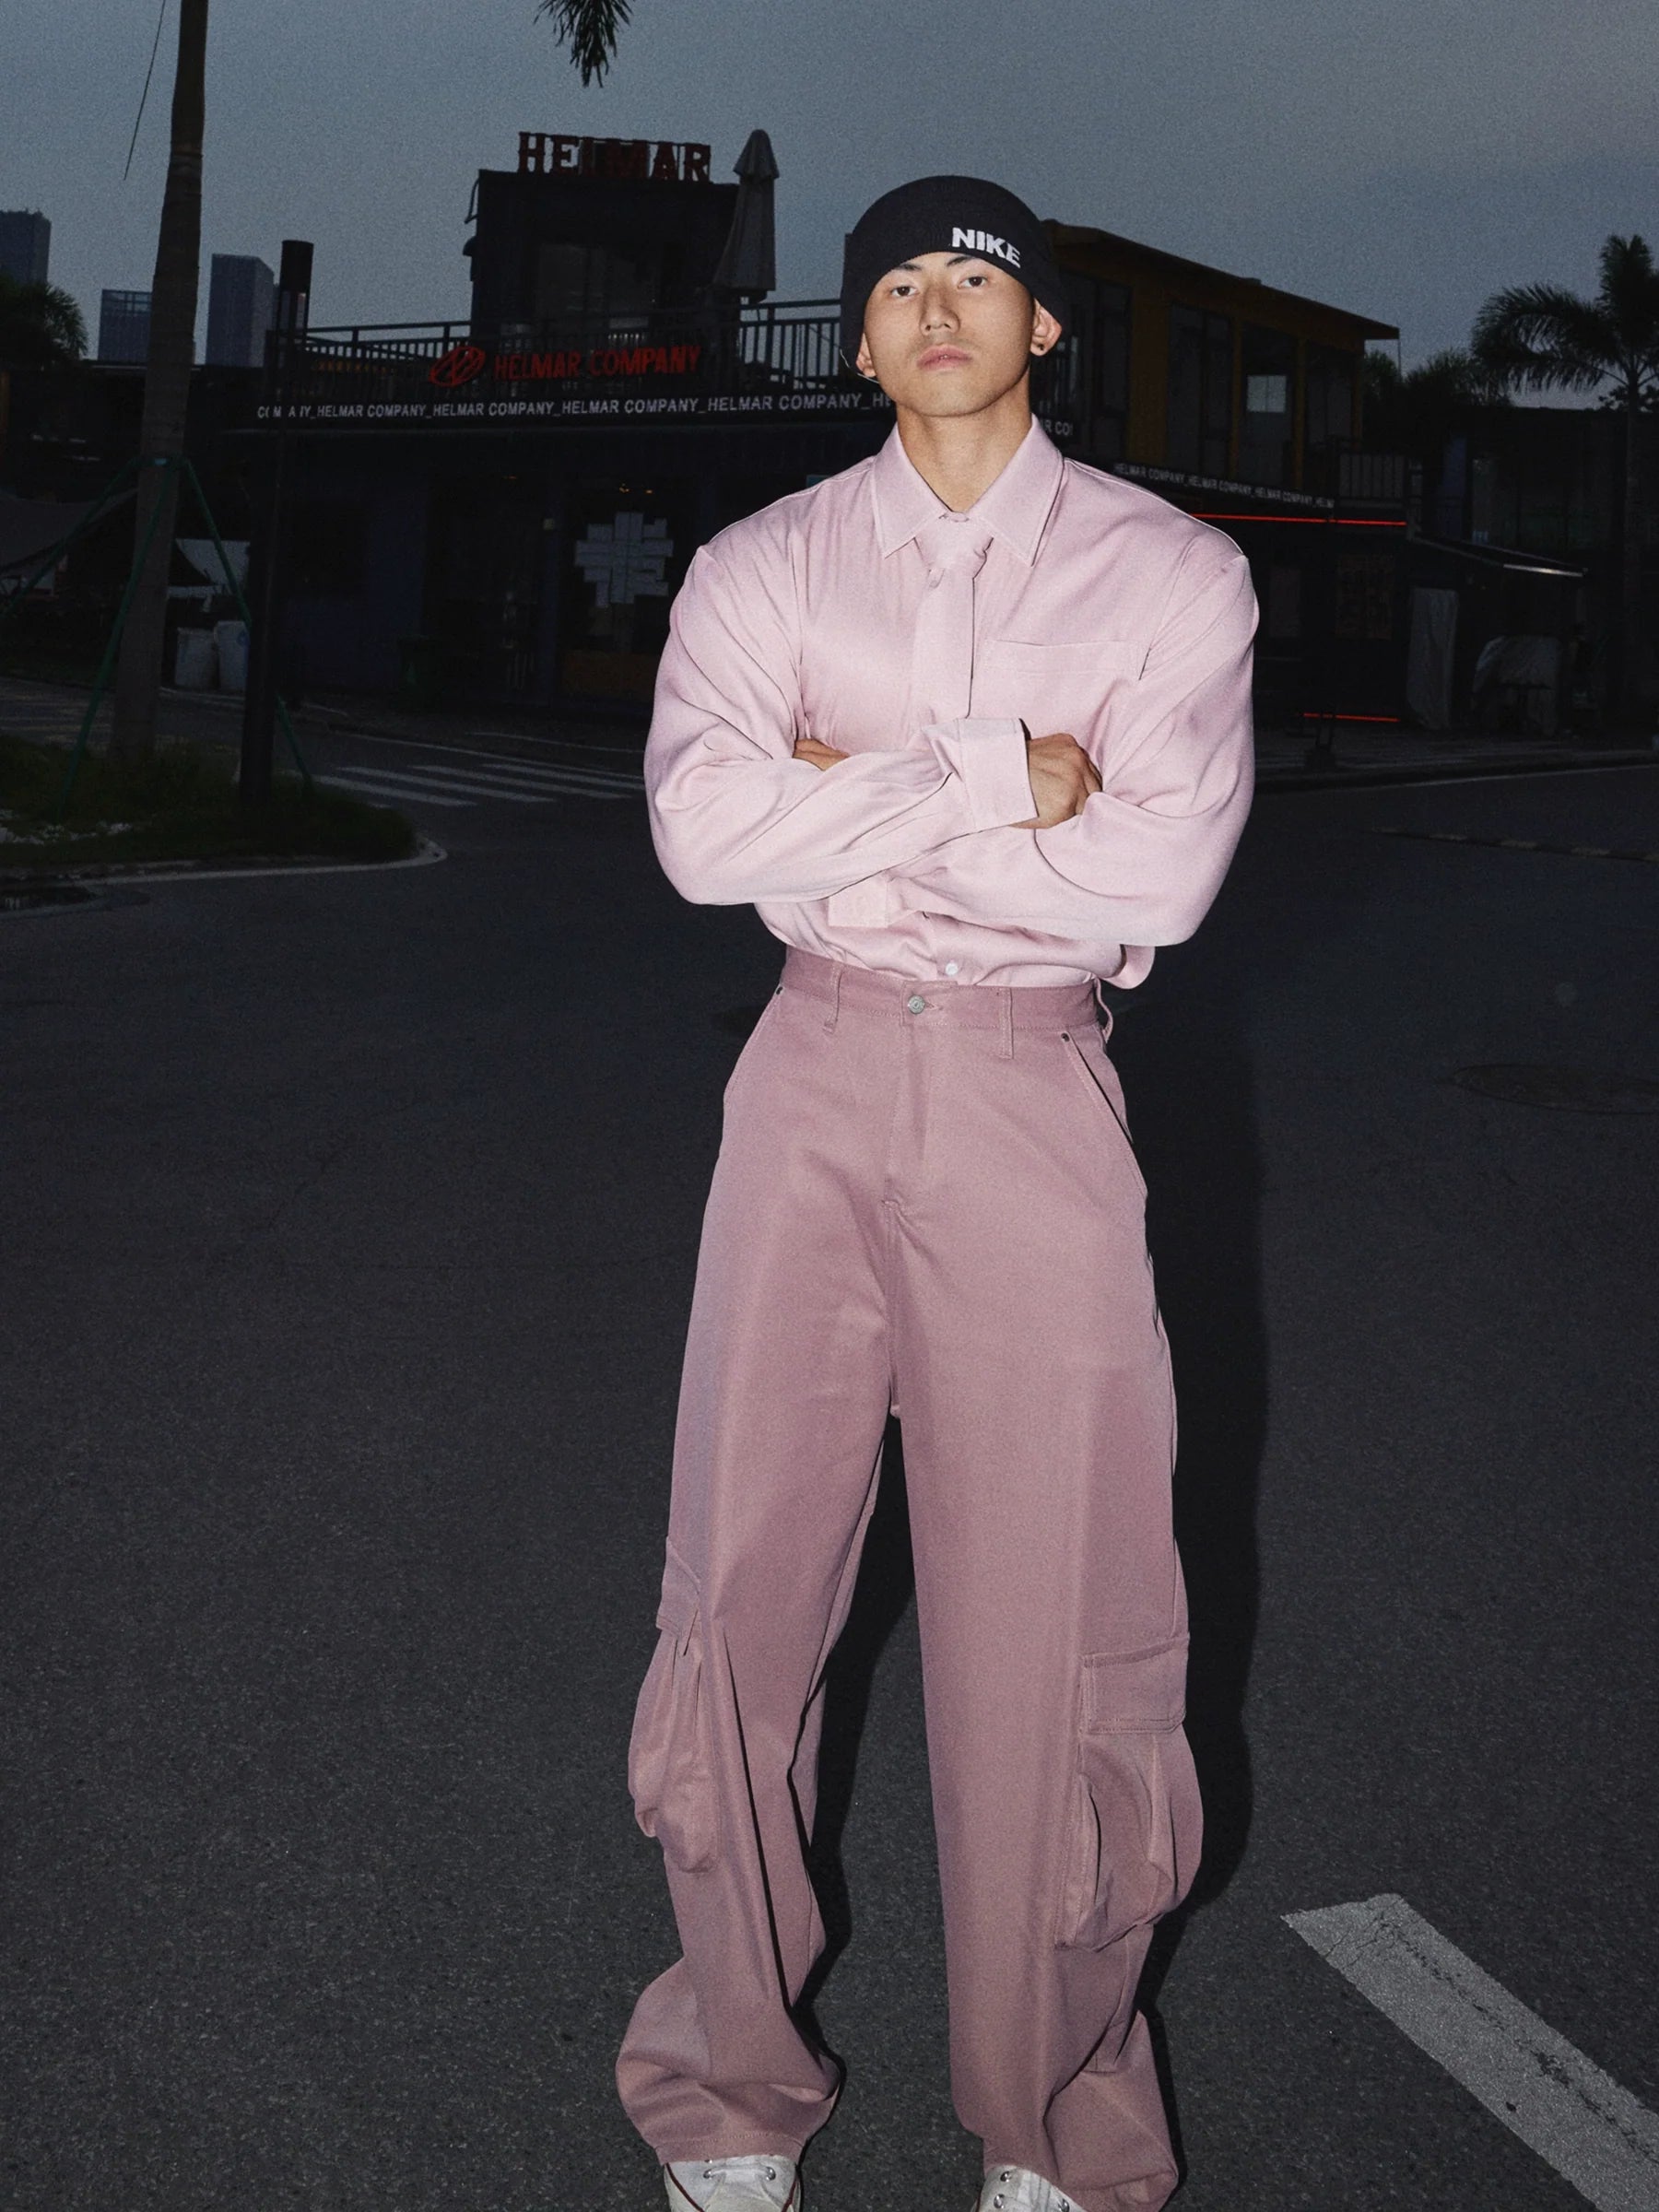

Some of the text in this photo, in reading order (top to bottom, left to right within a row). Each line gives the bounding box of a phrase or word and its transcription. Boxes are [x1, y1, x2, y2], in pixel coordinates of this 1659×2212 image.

[518, 131, 711, 183] HELMAR
[951, 227, 1021, 268] NIKE
[493, 345, 702, 381] HELMAR COMPANY
